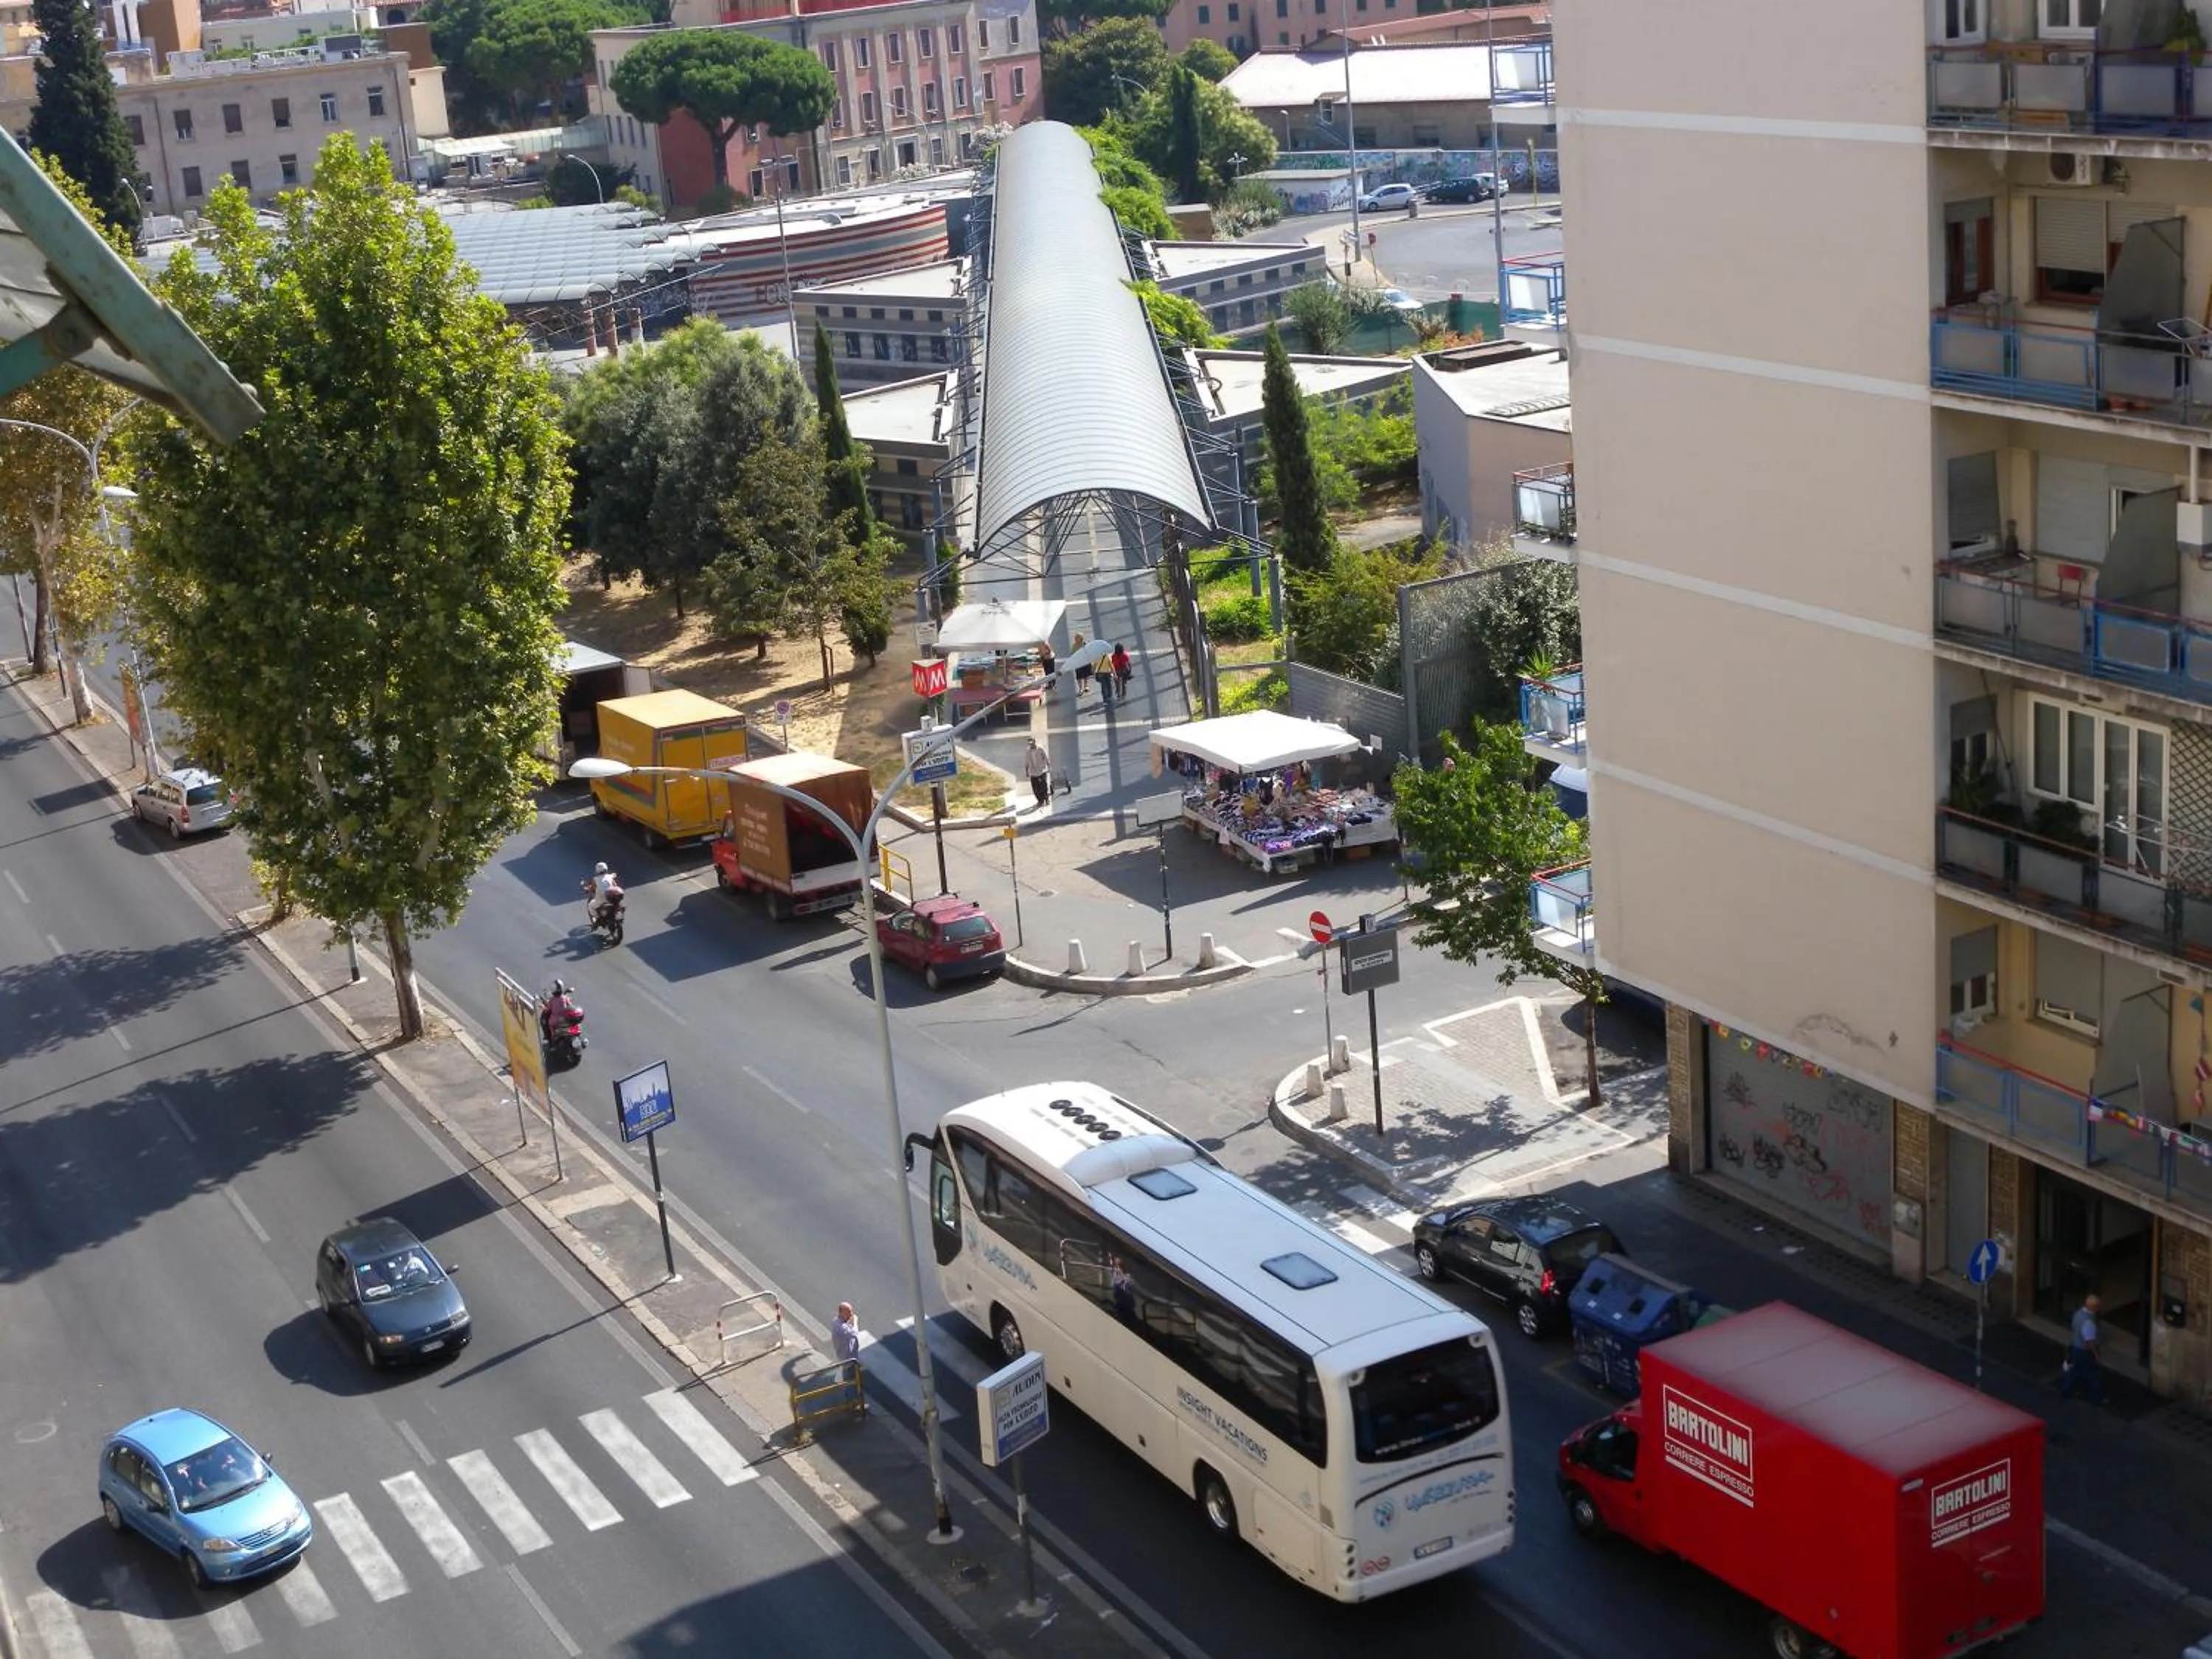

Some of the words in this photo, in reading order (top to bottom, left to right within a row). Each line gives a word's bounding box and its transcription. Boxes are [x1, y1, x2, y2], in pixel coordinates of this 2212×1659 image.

[915, 670, 927, 690] M
[930, 668, 945, 692] M
[1214, 1413, 1267, 1461] VACATIONS
[1667, 1399, 1748, 1467] BARTOLINI
[1664, 1441, 1706, 1472] CORRIERE
[1709, 1464, 1754, 1498] ESPRESSO
[1935, 1470, 2006, 1517] BARTOLINI
[1931, 1518, 1969, 1540] CORRIERE
[1972, 1502, 2011, 1524] ESPRESSO
